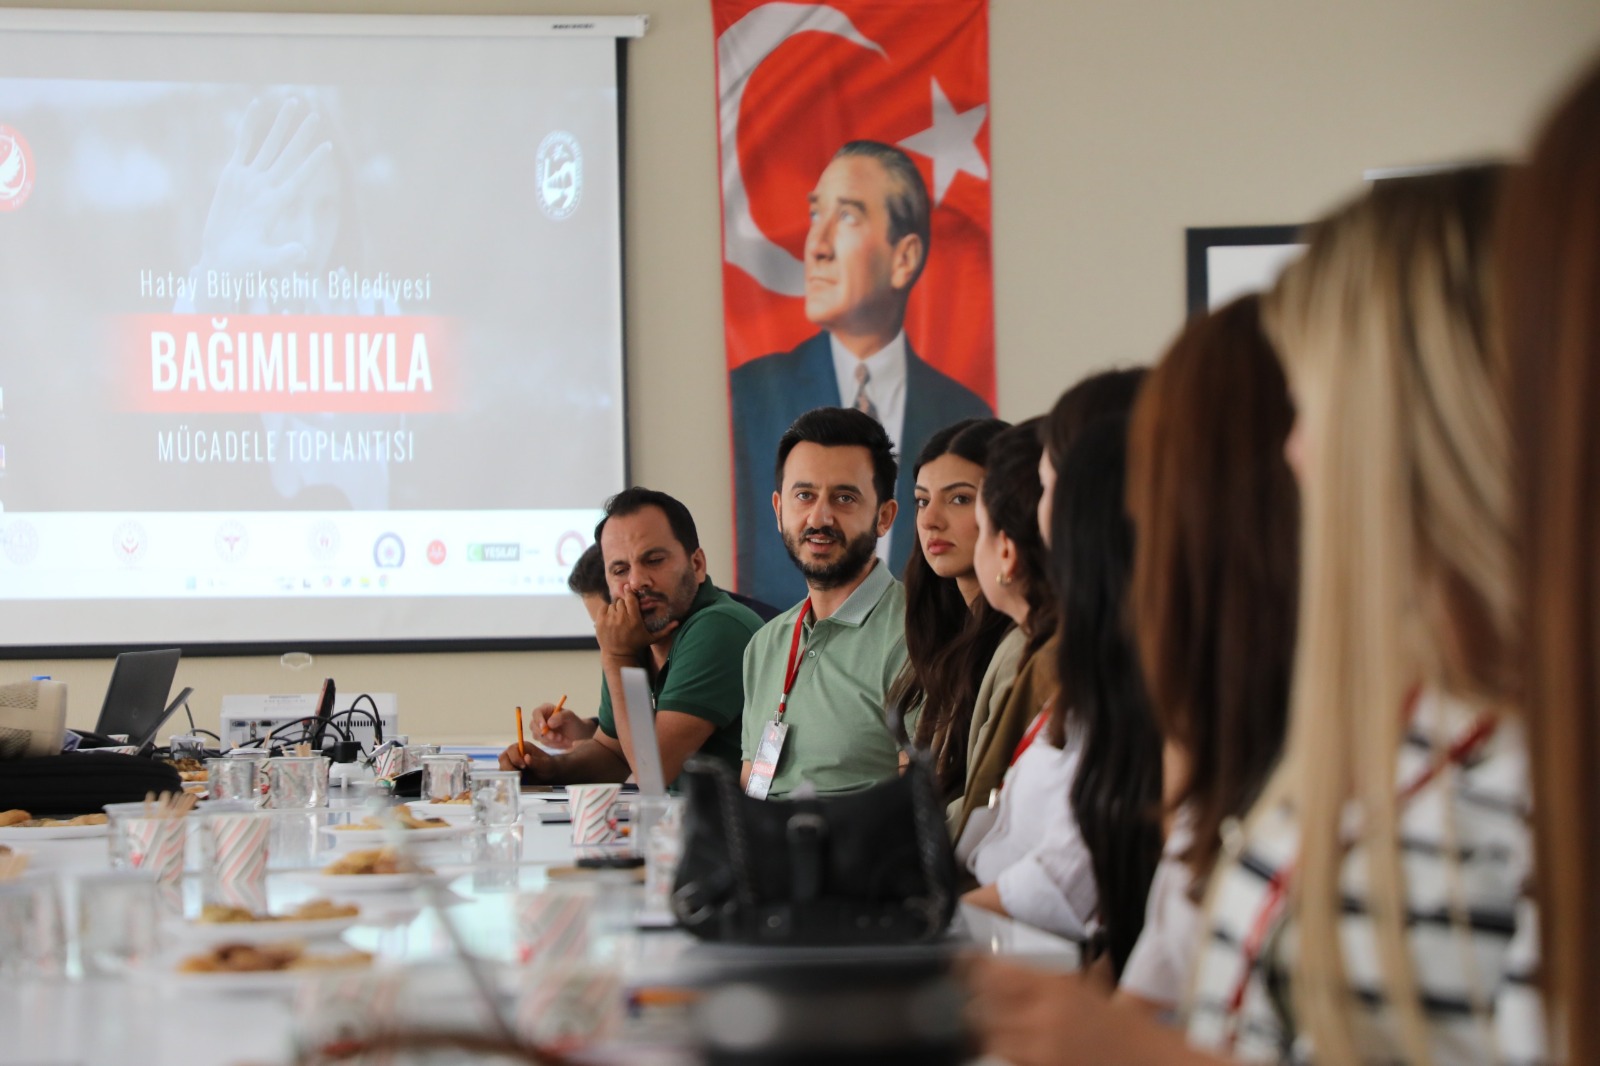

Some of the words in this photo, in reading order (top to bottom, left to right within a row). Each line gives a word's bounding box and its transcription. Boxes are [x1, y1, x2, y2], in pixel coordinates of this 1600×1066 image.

[140, 269, 197, 301] Hatay
[207, 269, 318, 303] Büyükşehir
[329, 271, 432, 302] Belediyesi
[150, 317, 433, 393] BAĞIMLILIKLA
[157, 427, 276, 463] MÜCADELE
[287, 431, 414, 463] TOPLANTISI
